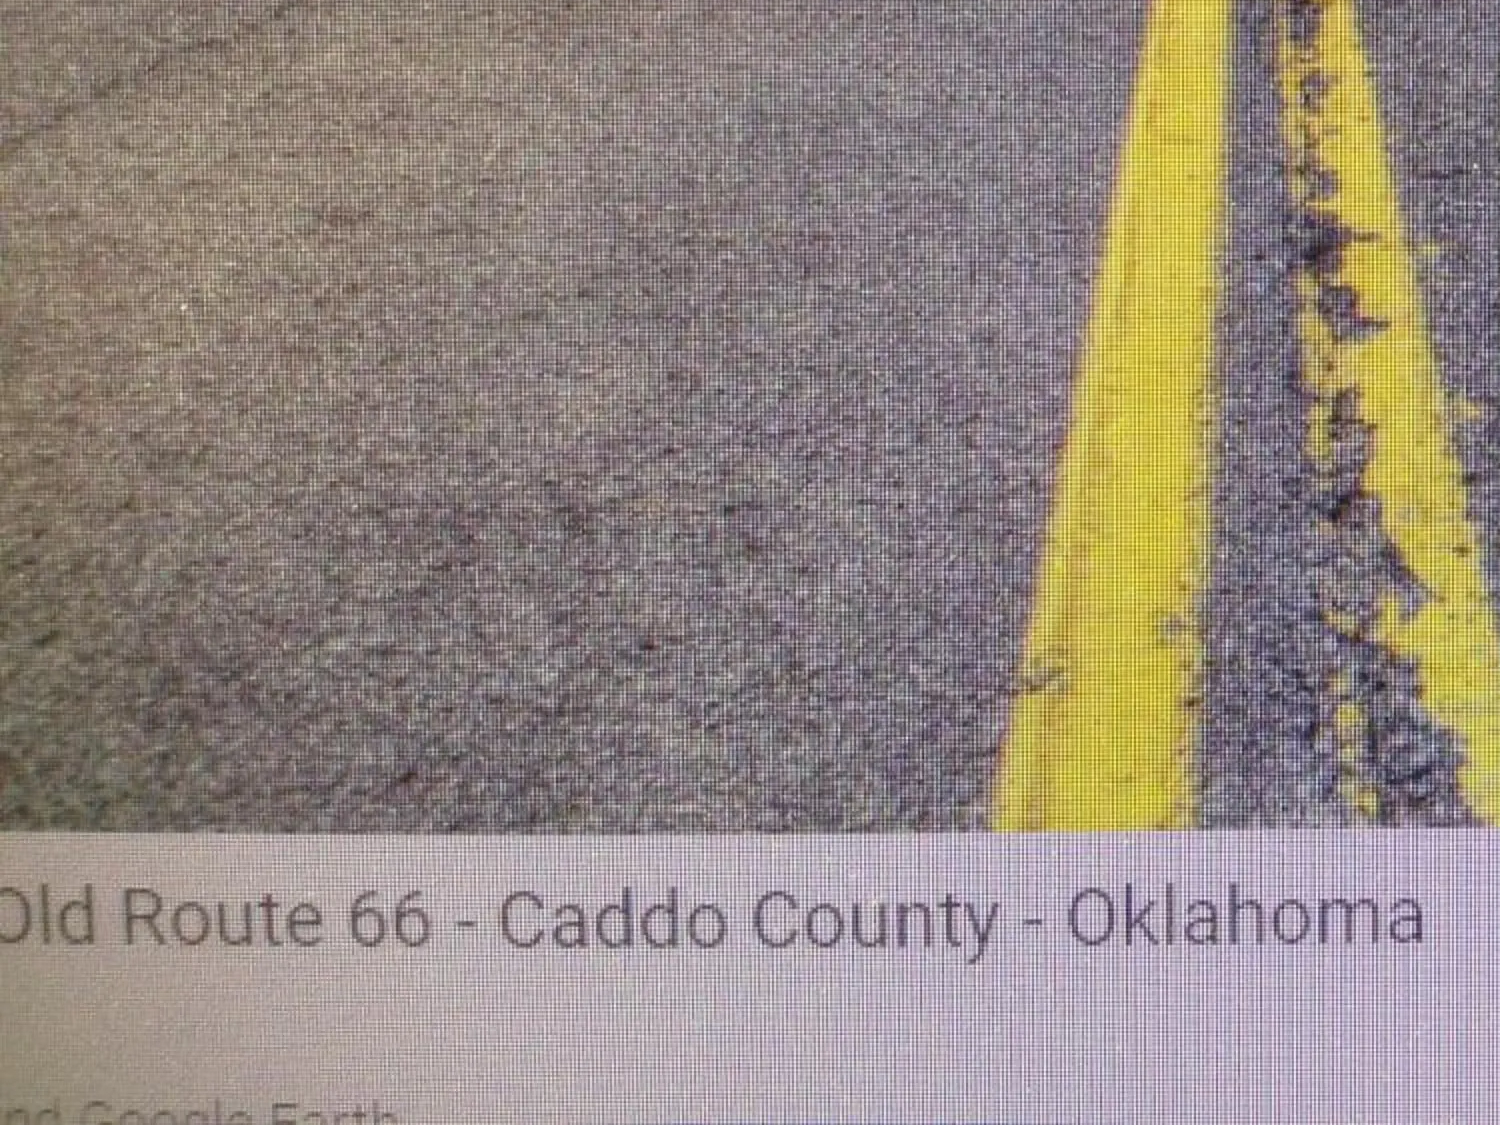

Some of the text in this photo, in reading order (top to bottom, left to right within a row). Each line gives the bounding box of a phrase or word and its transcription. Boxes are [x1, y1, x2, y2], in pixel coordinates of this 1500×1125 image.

[0, 883, 94, 945] Old
[124, 887, 323, 947] Route
[350, 890, 431, 948] 66
[501, 887, 727, 949] Caddo
[752, 891, 1000, 965] County
[1067, 883, 1425, 948] Oklahoma
